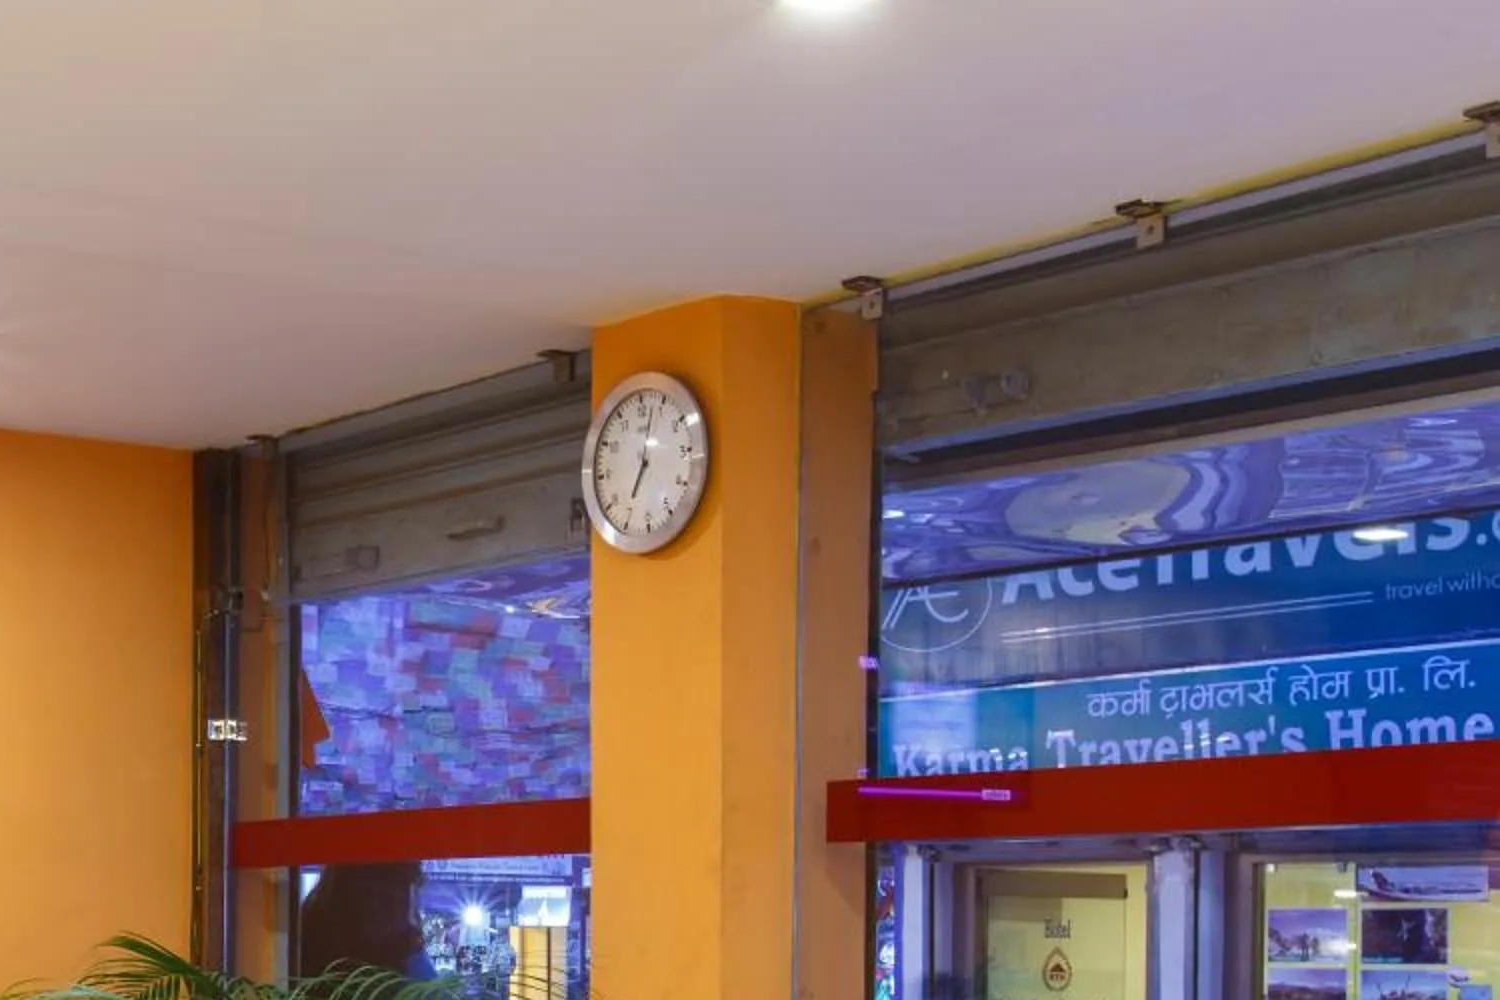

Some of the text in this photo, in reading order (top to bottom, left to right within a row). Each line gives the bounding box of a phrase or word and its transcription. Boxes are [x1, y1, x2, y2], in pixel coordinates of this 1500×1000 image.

[1386, 577, 1443, 600] travel
[1288, 664, 1353, 706] होम
[1422, 655, 1476, 691] लि.
[893, 708, 1495, 777] Karma Traveller's Home
[1044, 918, 1071, 939] Hotel
